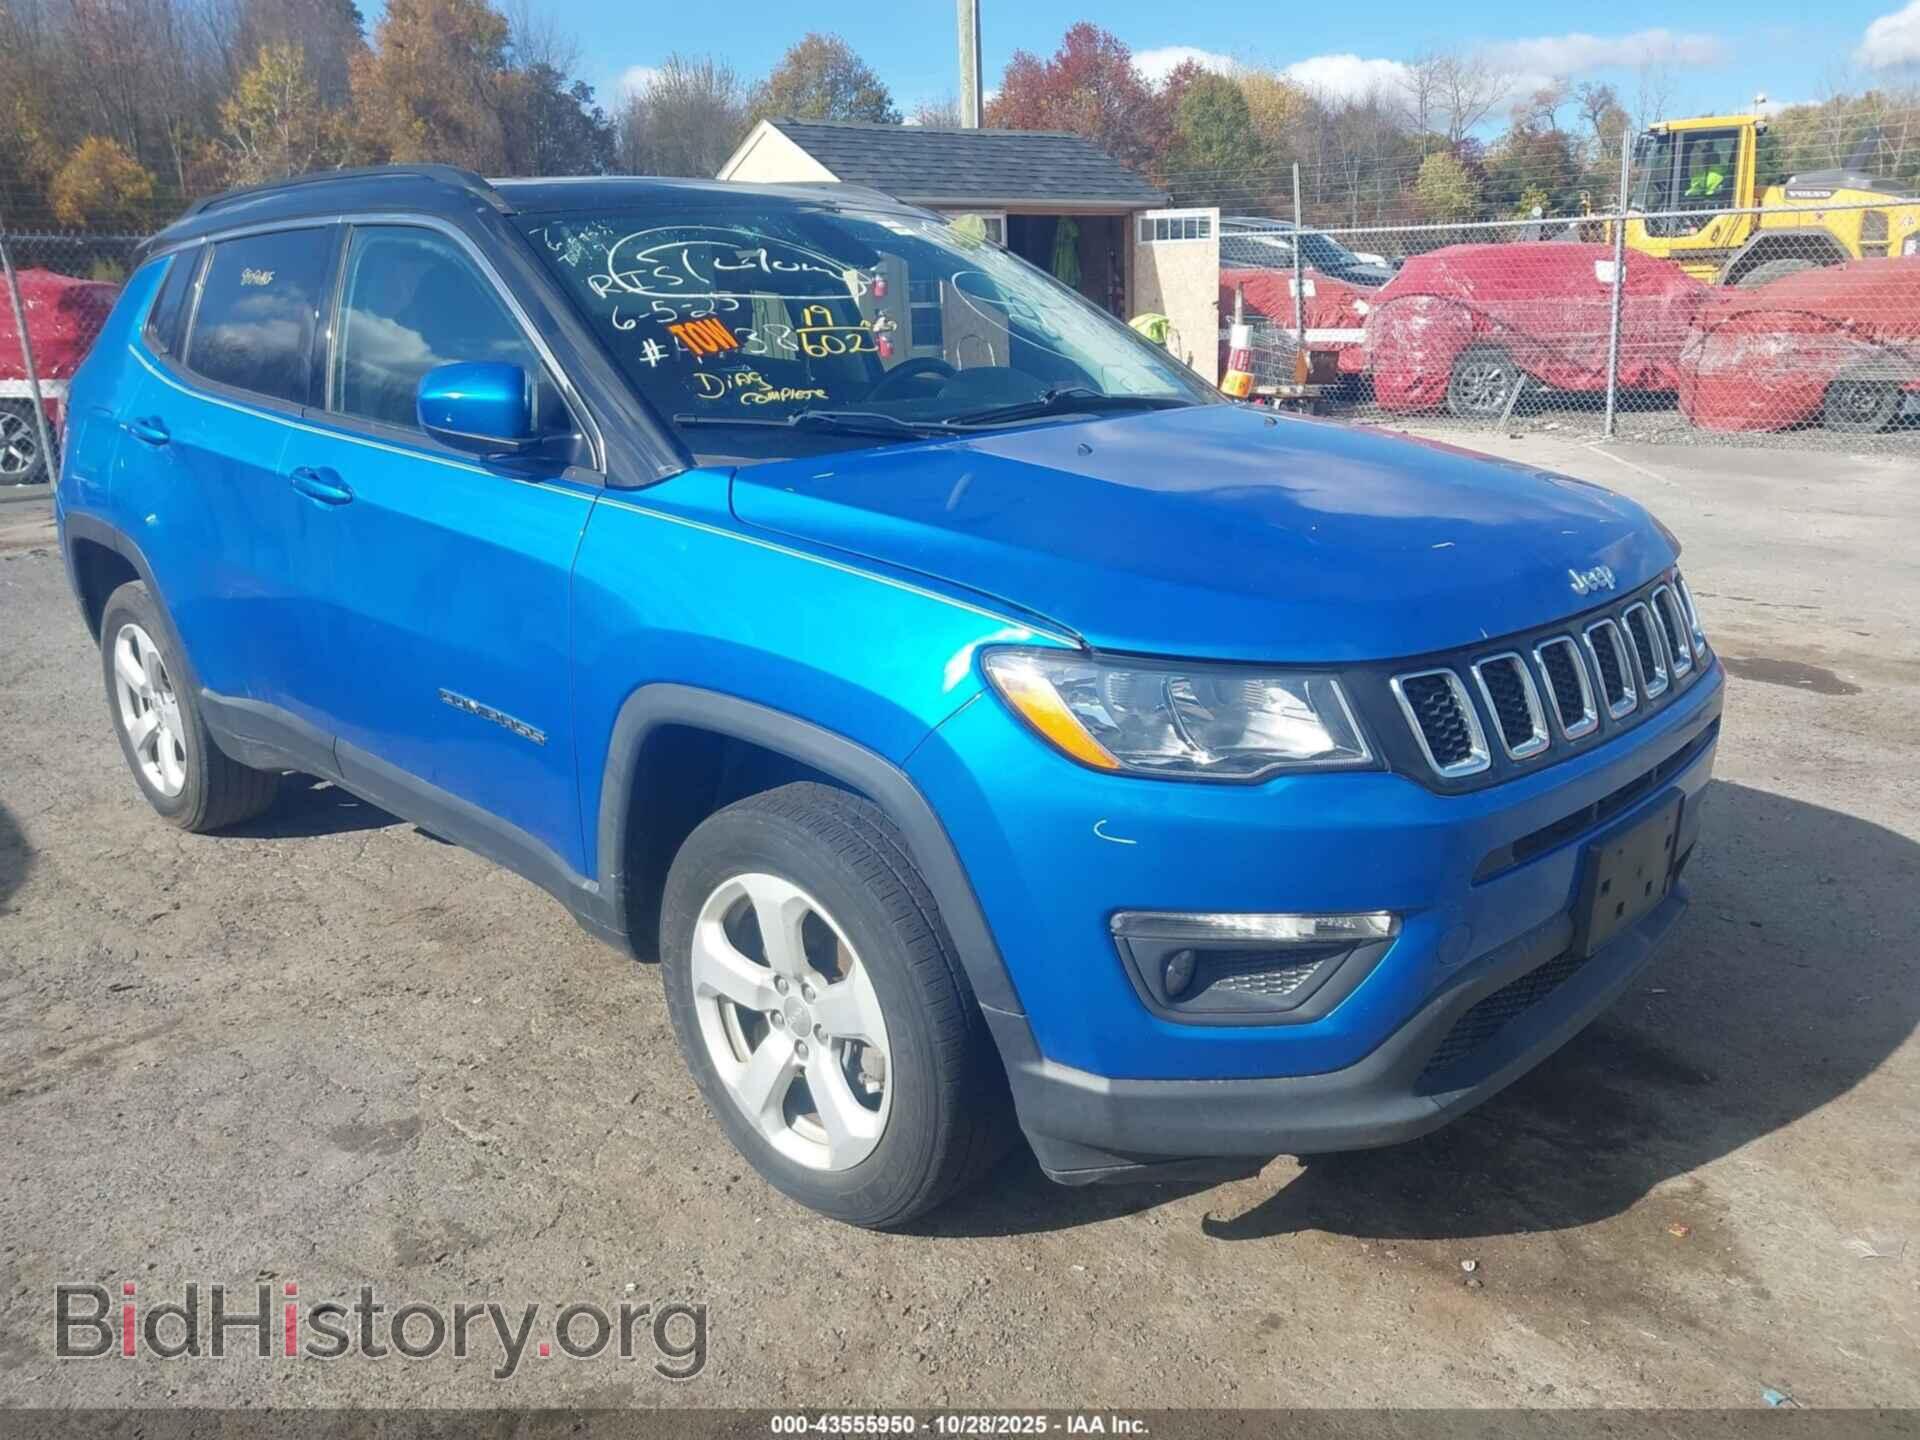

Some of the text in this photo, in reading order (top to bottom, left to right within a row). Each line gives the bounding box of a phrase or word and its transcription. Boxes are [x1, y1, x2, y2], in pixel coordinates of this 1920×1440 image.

[666, 318, 741, 358] TOW
[801, 332, 880, 358] 602
[1567, 566, 1616, 595] Jeep
